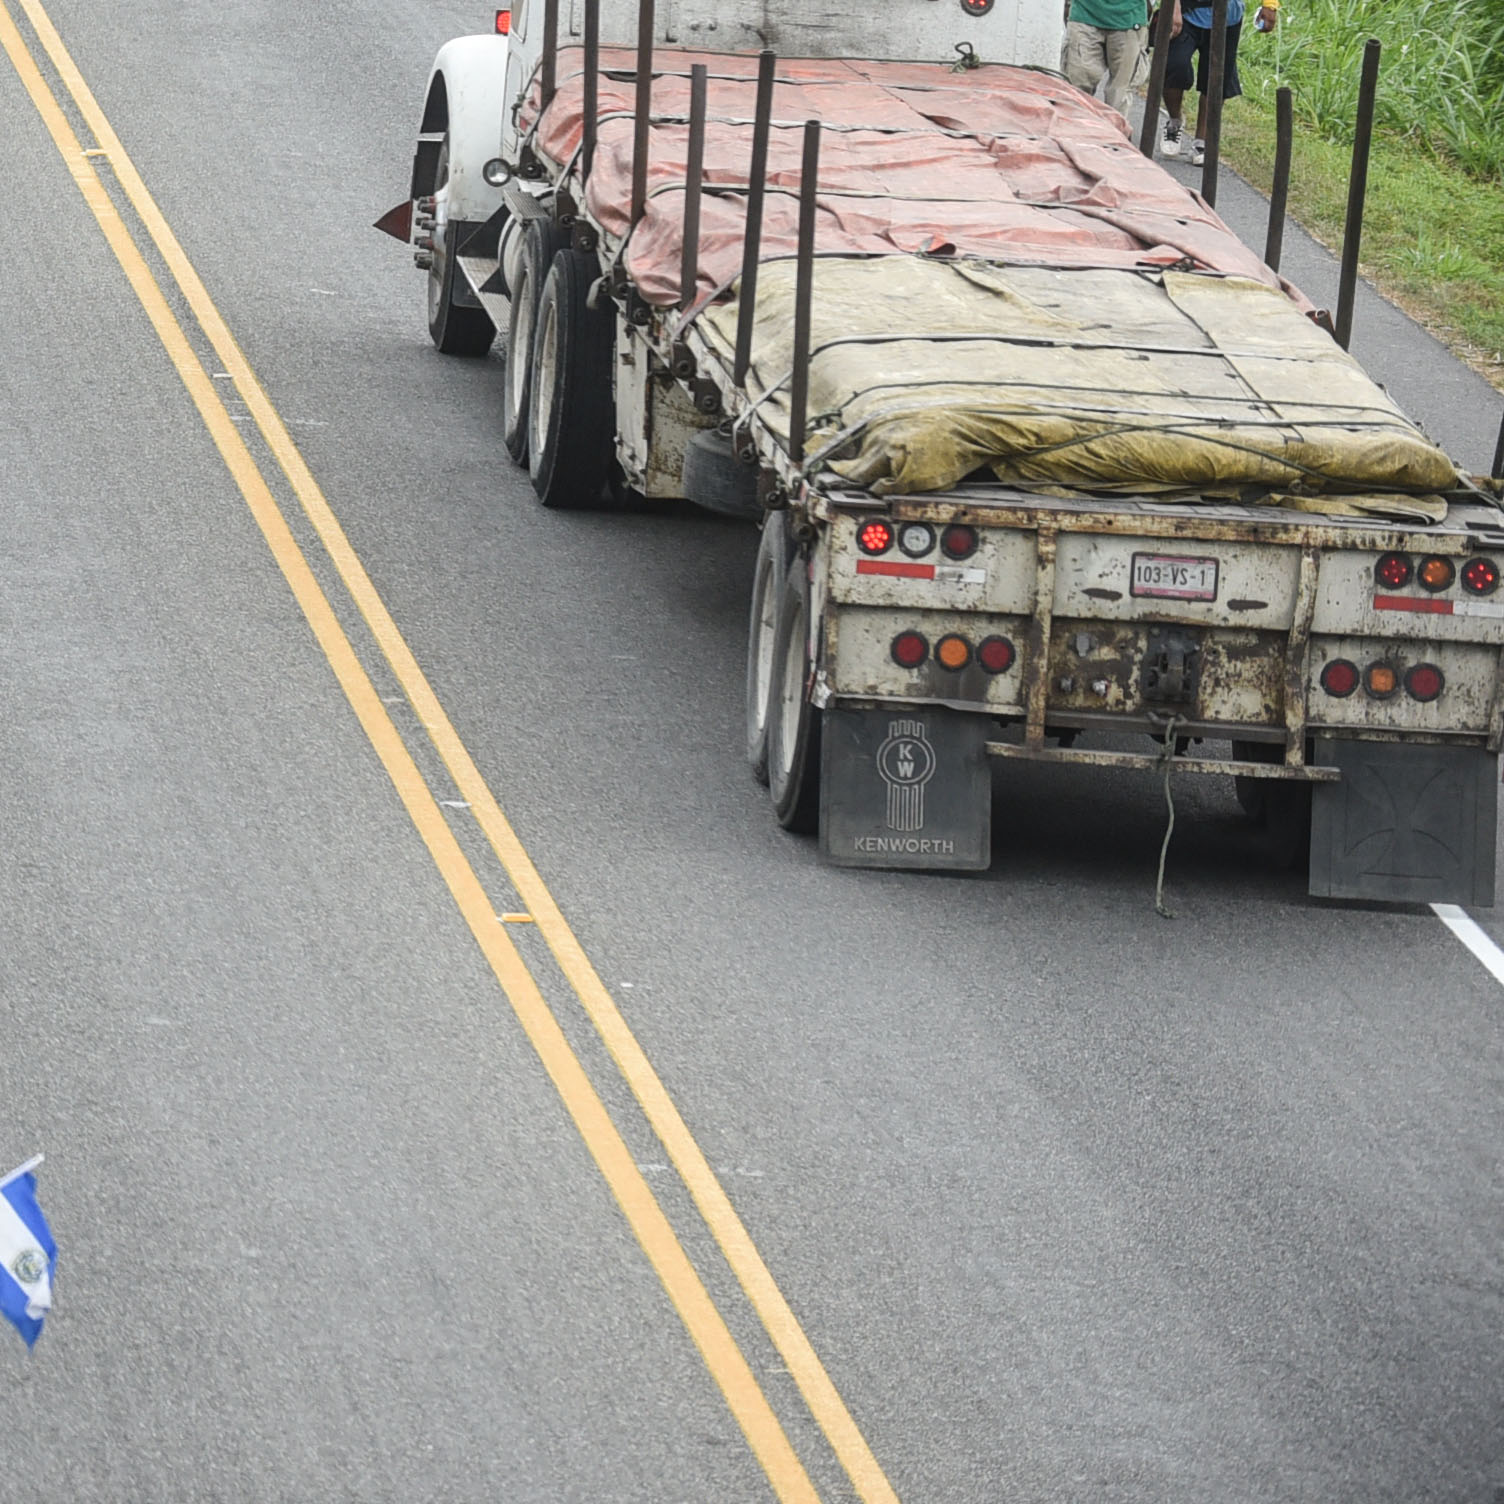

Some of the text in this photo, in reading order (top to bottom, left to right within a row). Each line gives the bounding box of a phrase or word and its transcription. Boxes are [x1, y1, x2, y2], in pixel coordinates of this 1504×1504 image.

[1136, 565, 1206, 587] 103-VS-1
[899, 743, 913, 760] K
[897, 761, 915, 778] W
[854, 838, 954, 854] KENWORTH
